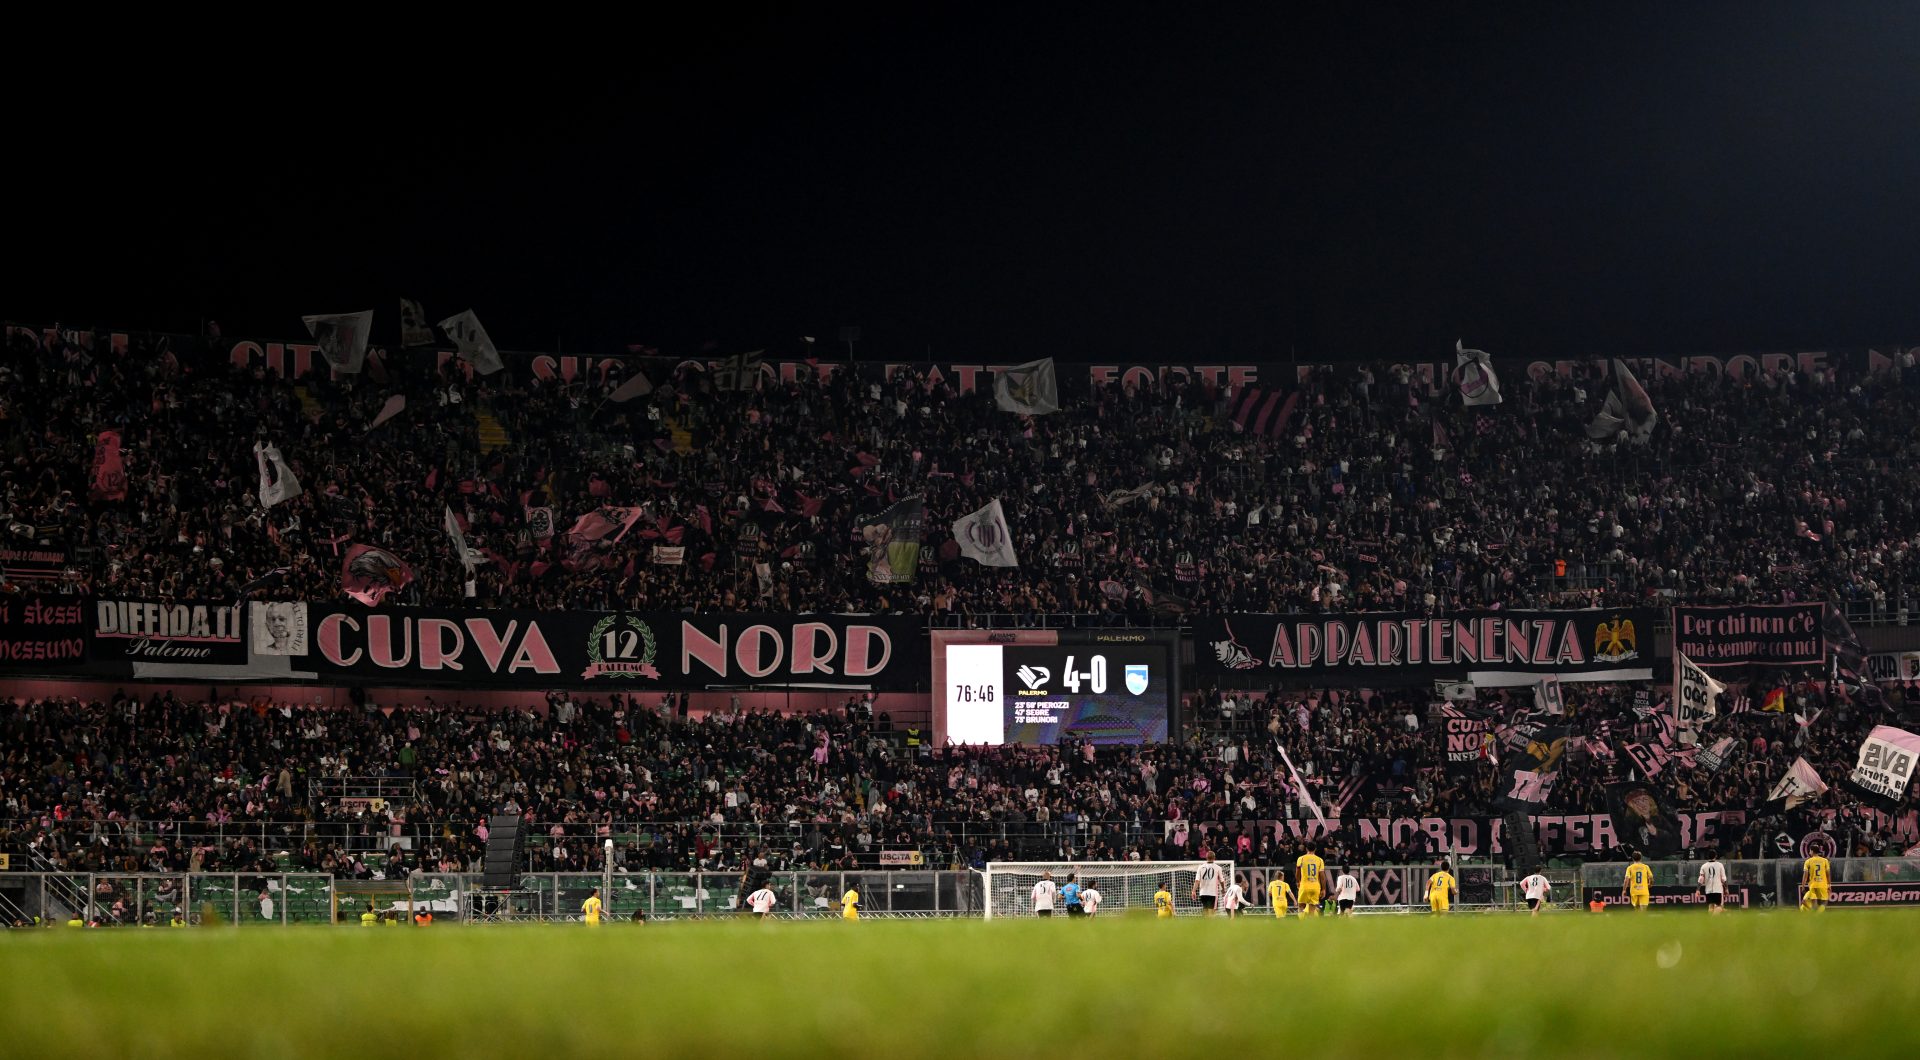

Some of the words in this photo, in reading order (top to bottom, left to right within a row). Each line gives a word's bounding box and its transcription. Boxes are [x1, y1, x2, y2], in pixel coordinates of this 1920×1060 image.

[23, 598, 83, 625] stessi
[97, 600, 242, 639] DIFFIDATI
[1683, 614, 1714, 636] Per
[1718, 612, 1746, 636] chi
[1750, 615, 1785, 634] non
[1788, 610, 1815, 633] c'è
[125, 636, 211, 658] Palermo
[317, 613, 562, 674] CURVA
[681, 619, 892, 678] NORD
[602, 629, 639, 659] 12
[1268, 617, 1586, 668] APPARTENENZA
[1682, 641, 1705, 657] ma
[1707, 639, 1716, 658] è
[1717, 640, 1766, 658] sempre
[1769, 641, 1793, 656] con
[1795, 636, 1817, 656] noi
[597, 663, 645, 673] PALERMO
[1063, 655, 1107, 694] 4-0
[956, 684, 994, 702] 76:46
[1358, 817, 1478, 855] NORD
[1202, 866, 1215, 880] 20
[1307, 863, 1316, 876] 13
[1635, 872, 1642, 884] 8
[1815, 864, 1821, 876] 2
[1345, 878, 1353, 889] 10
[1829, 888, 1920, 904] orzapalerm
